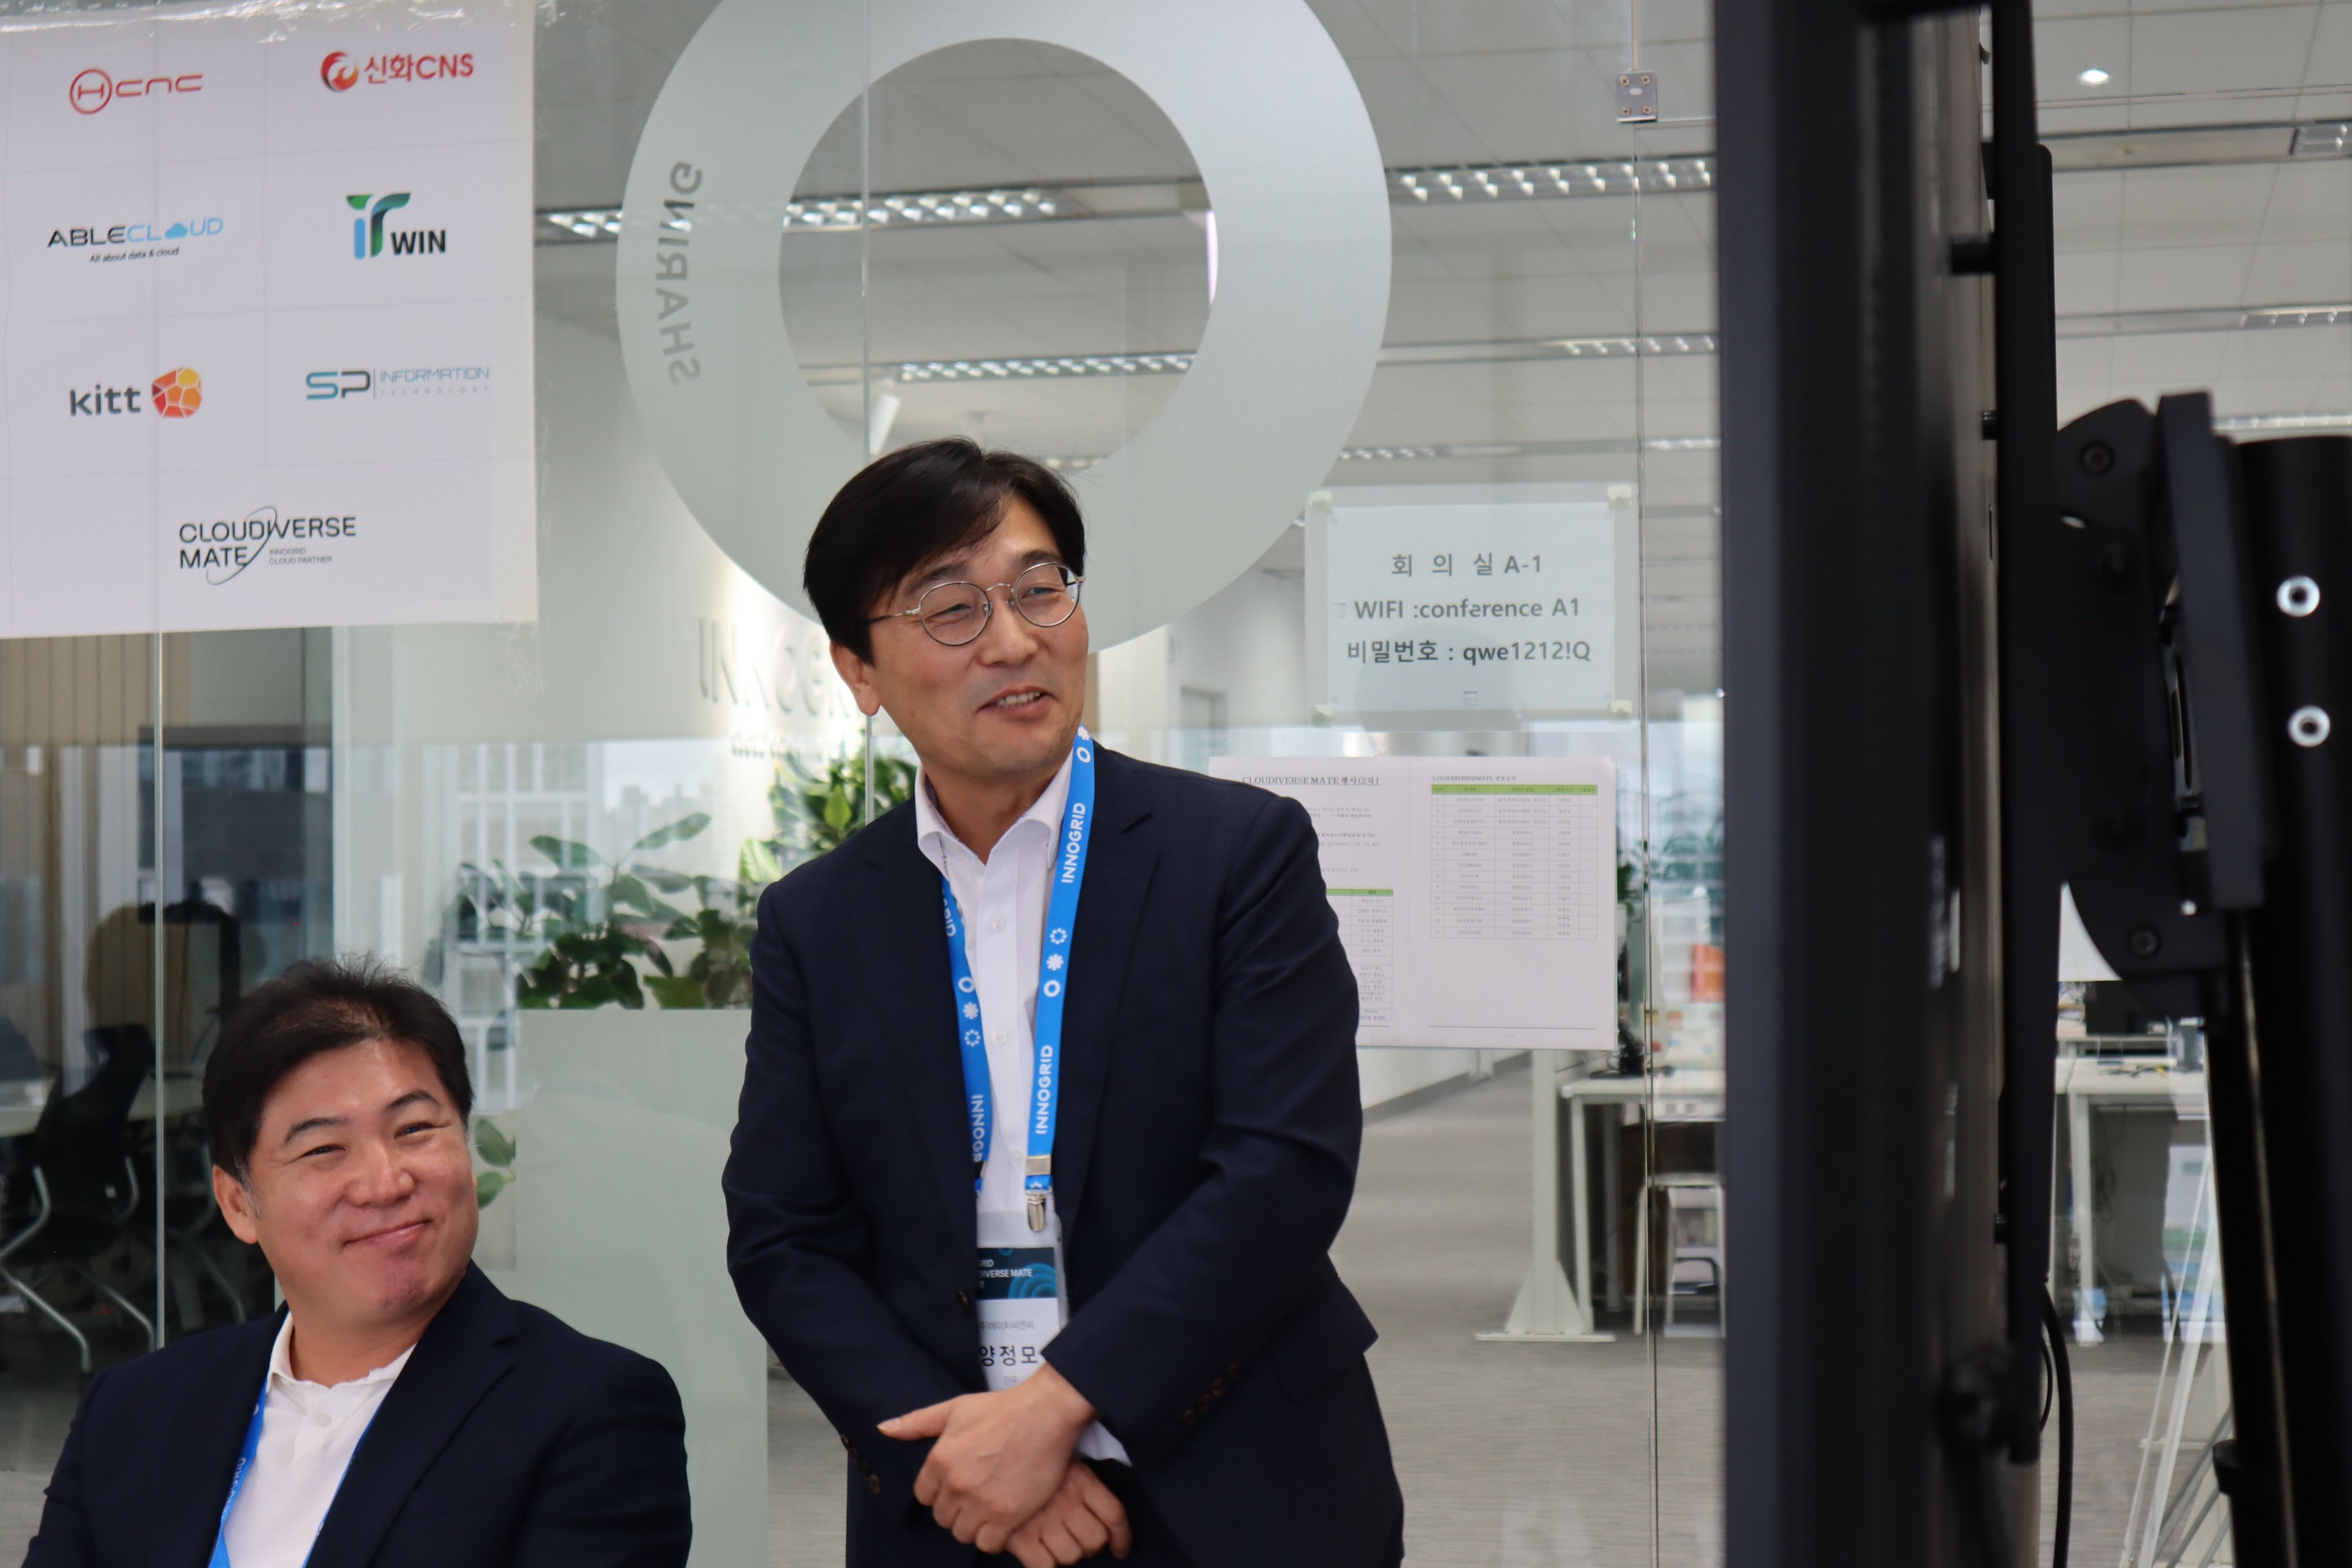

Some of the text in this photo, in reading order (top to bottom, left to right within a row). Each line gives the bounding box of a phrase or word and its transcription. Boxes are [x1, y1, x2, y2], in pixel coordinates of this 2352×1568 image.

[363, 53, 474, 85] 신화CNS
[102, 252, 126, 262] about
[128, 249, 146, 260] data
[156, 246, 179, 257] cloud
[390, 229, 446, 256] WIN
[306, 368, 489, 399] SP INFORMATION
[70, 383, 141, 417] kitt
[179, 517, 356, 543] CLOUDIVERSE
[179, 546, 247, 569] MATE
[298, 556, 333, 565] PARTNER
[1504, 555, 1542, 574] A-1
[1354, 601, 1404, 619] WIFI
[1551, 598, 1580, 616] A1
[1348, 640, 1438, 664] 비밀번호
[1463, 641, 1592, 666] qwe1212!Q
[1061, 802, 1086, 884] INNOGRID
[1035, 1045, 1054, 1134] INNOGRID
